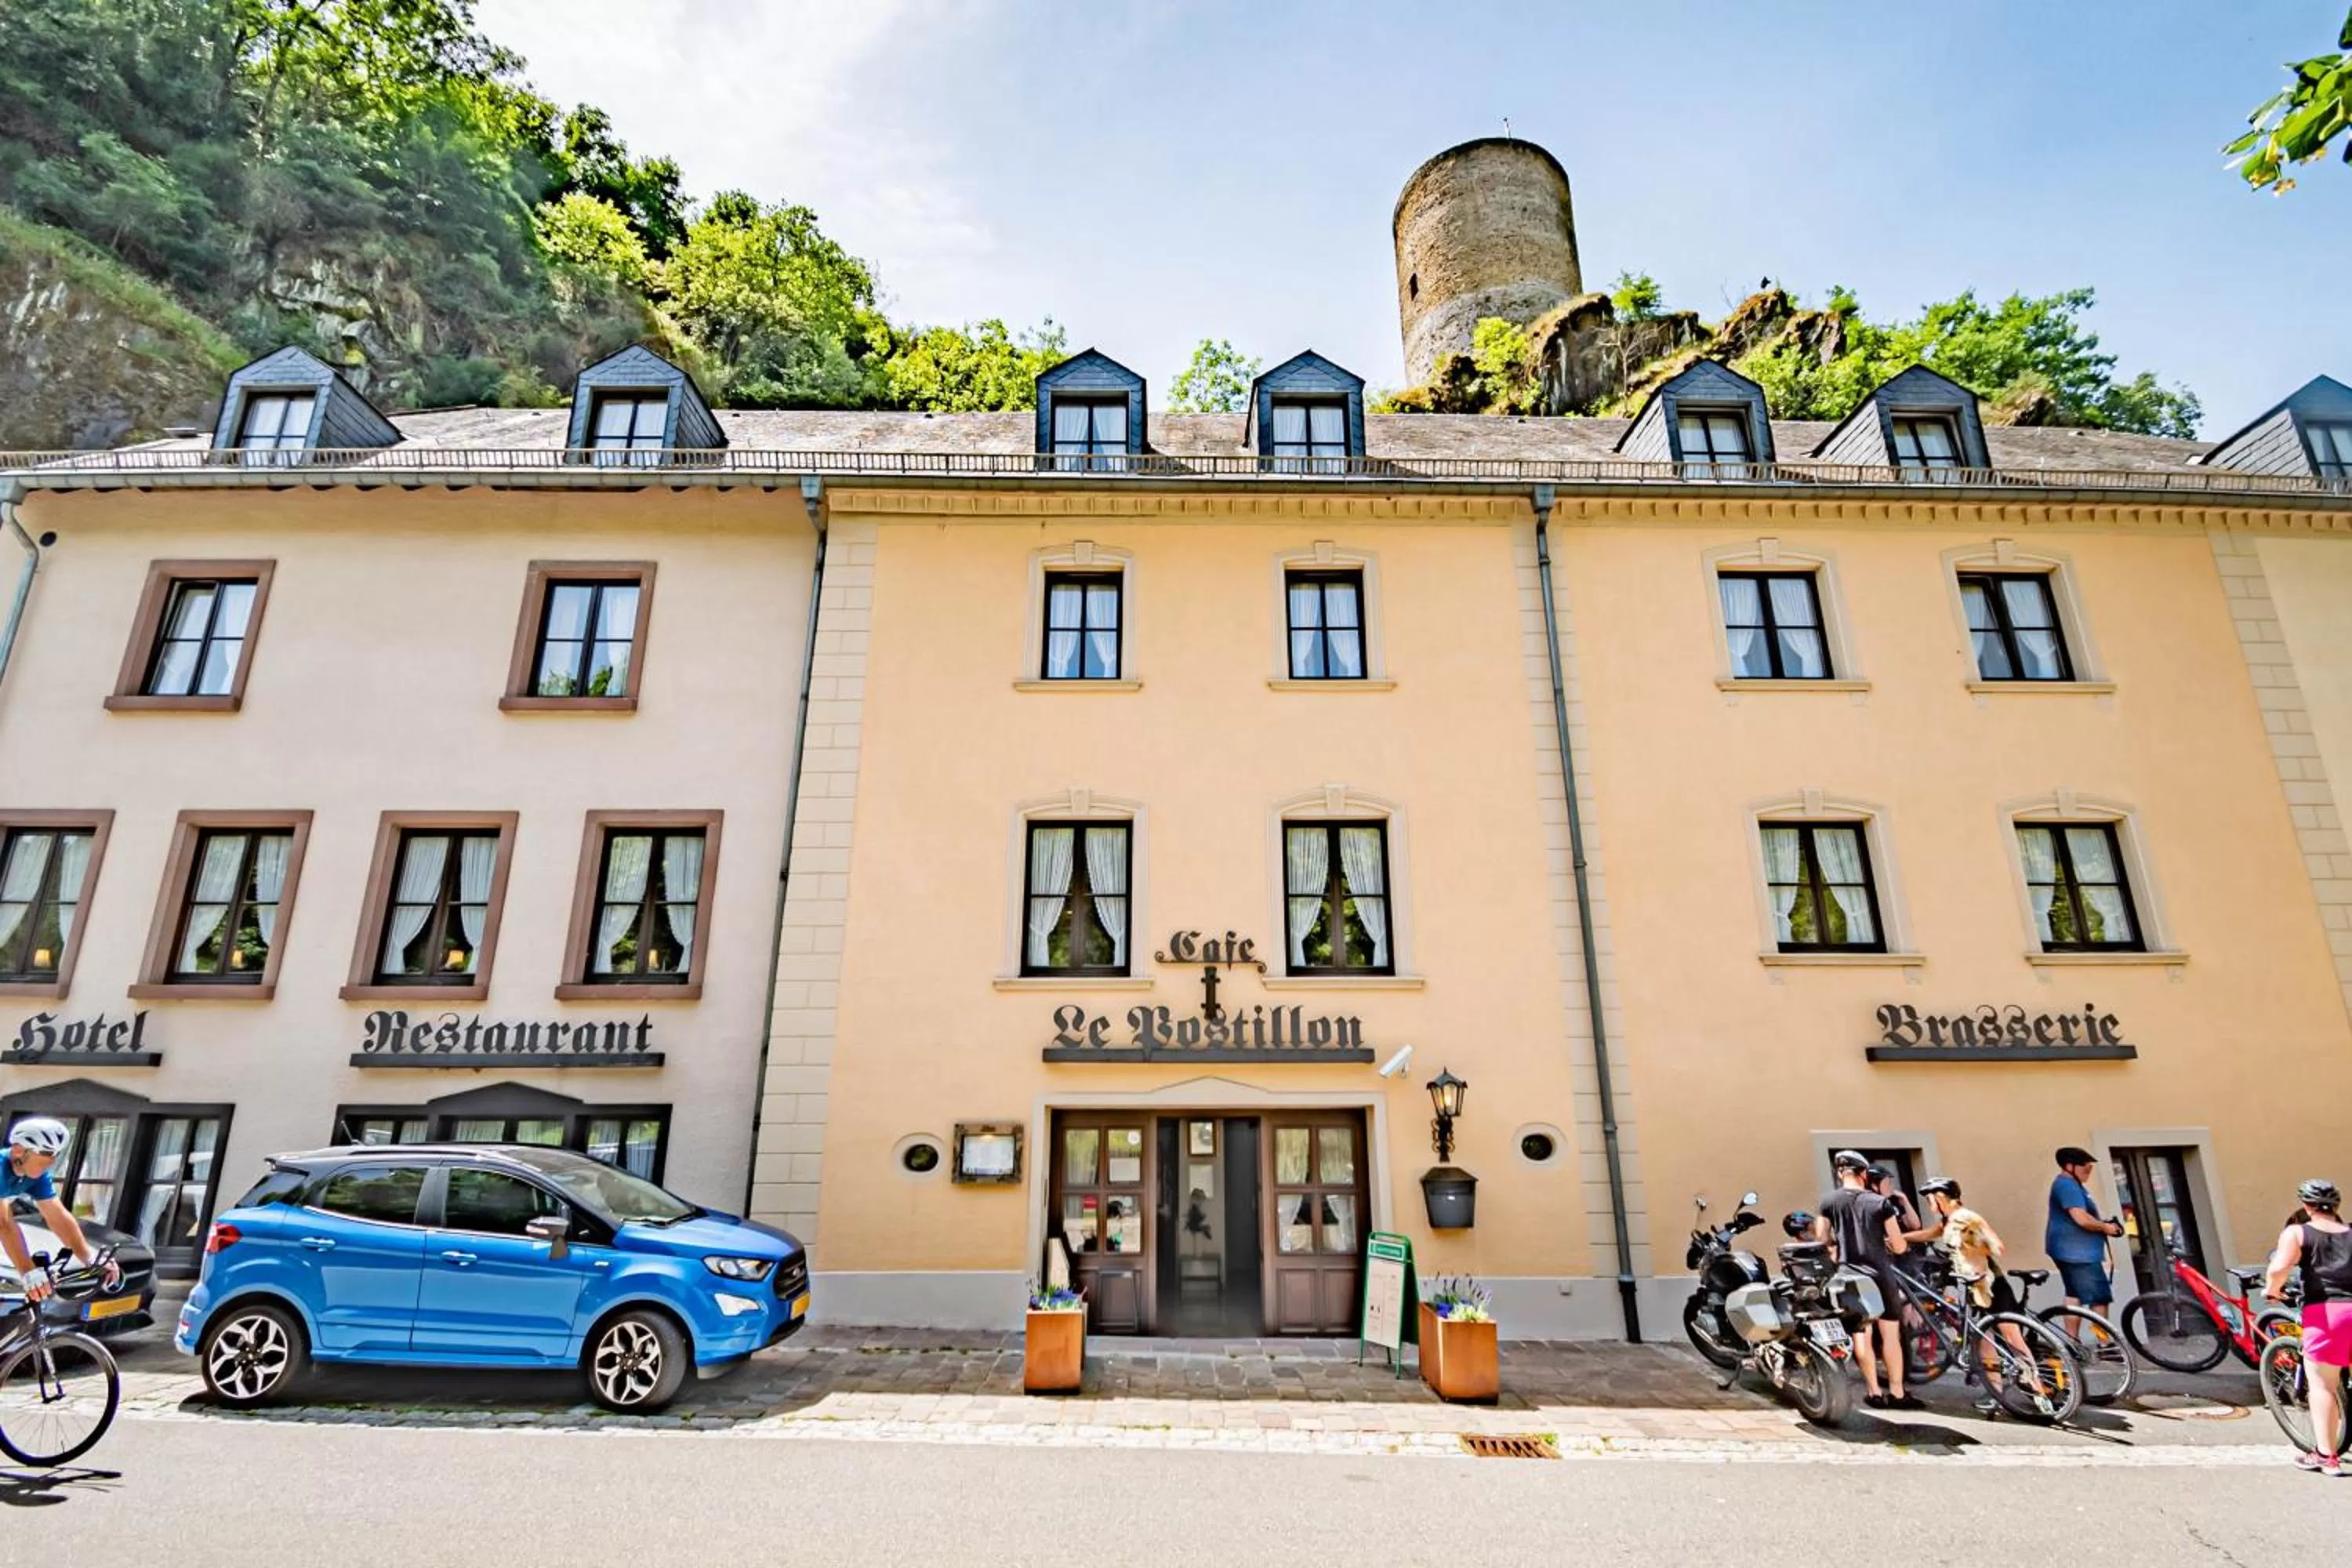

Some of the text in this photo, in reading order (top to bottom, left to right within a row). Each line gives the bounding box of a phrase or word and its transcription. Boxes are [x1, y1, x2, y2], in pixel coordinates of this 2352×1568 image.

[13, 1010, 150, 1060] Hotel
[363, 1011, 652, 1054] Restaurant
[1053, 1004, 1364, 1058] Le Postillon
[1876, 1003, 2123, 1047] Brasserie
